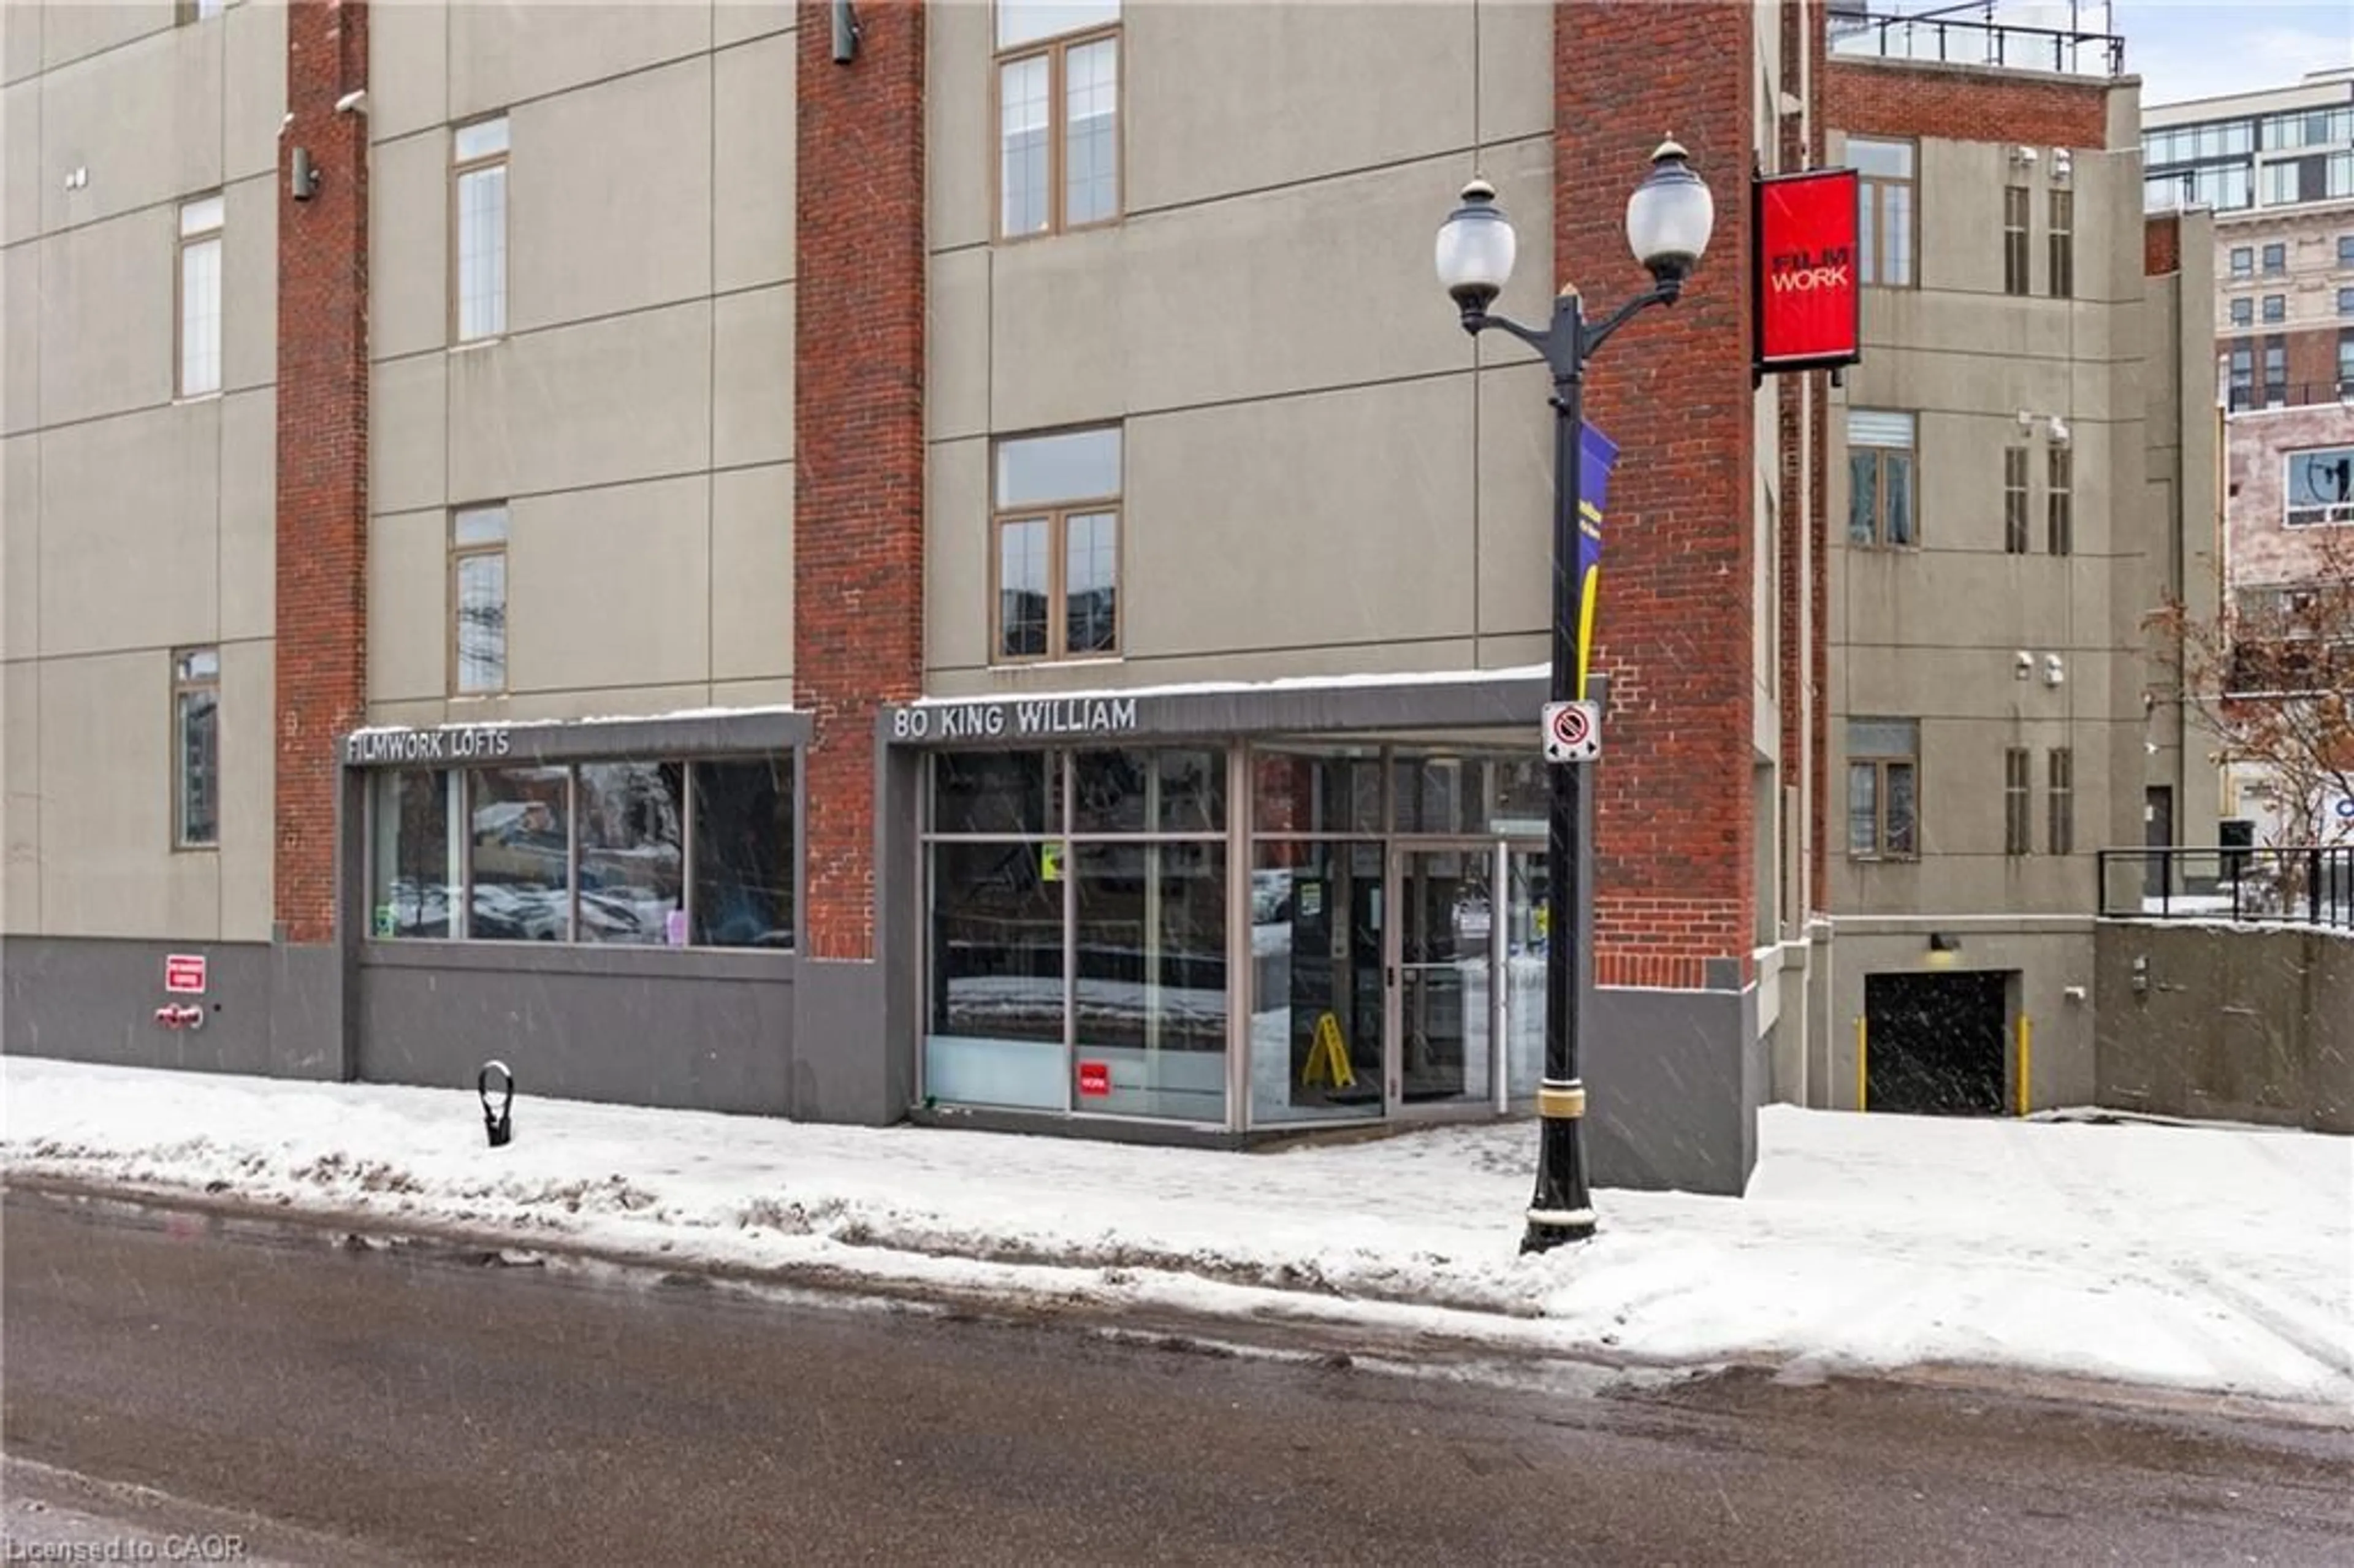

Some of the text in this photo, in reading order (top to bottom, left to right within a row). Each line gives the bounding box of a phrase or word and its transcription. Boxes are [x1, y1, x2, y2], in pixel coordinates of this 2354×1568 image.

[1773, 248, 1848, 273] FILM
[1772, 265, 1848, 293] WORK
[894, 698, 1135, 737] 80 KING WILLIAM
[349, 726, 510, 763] FILMWORK LOFTS
